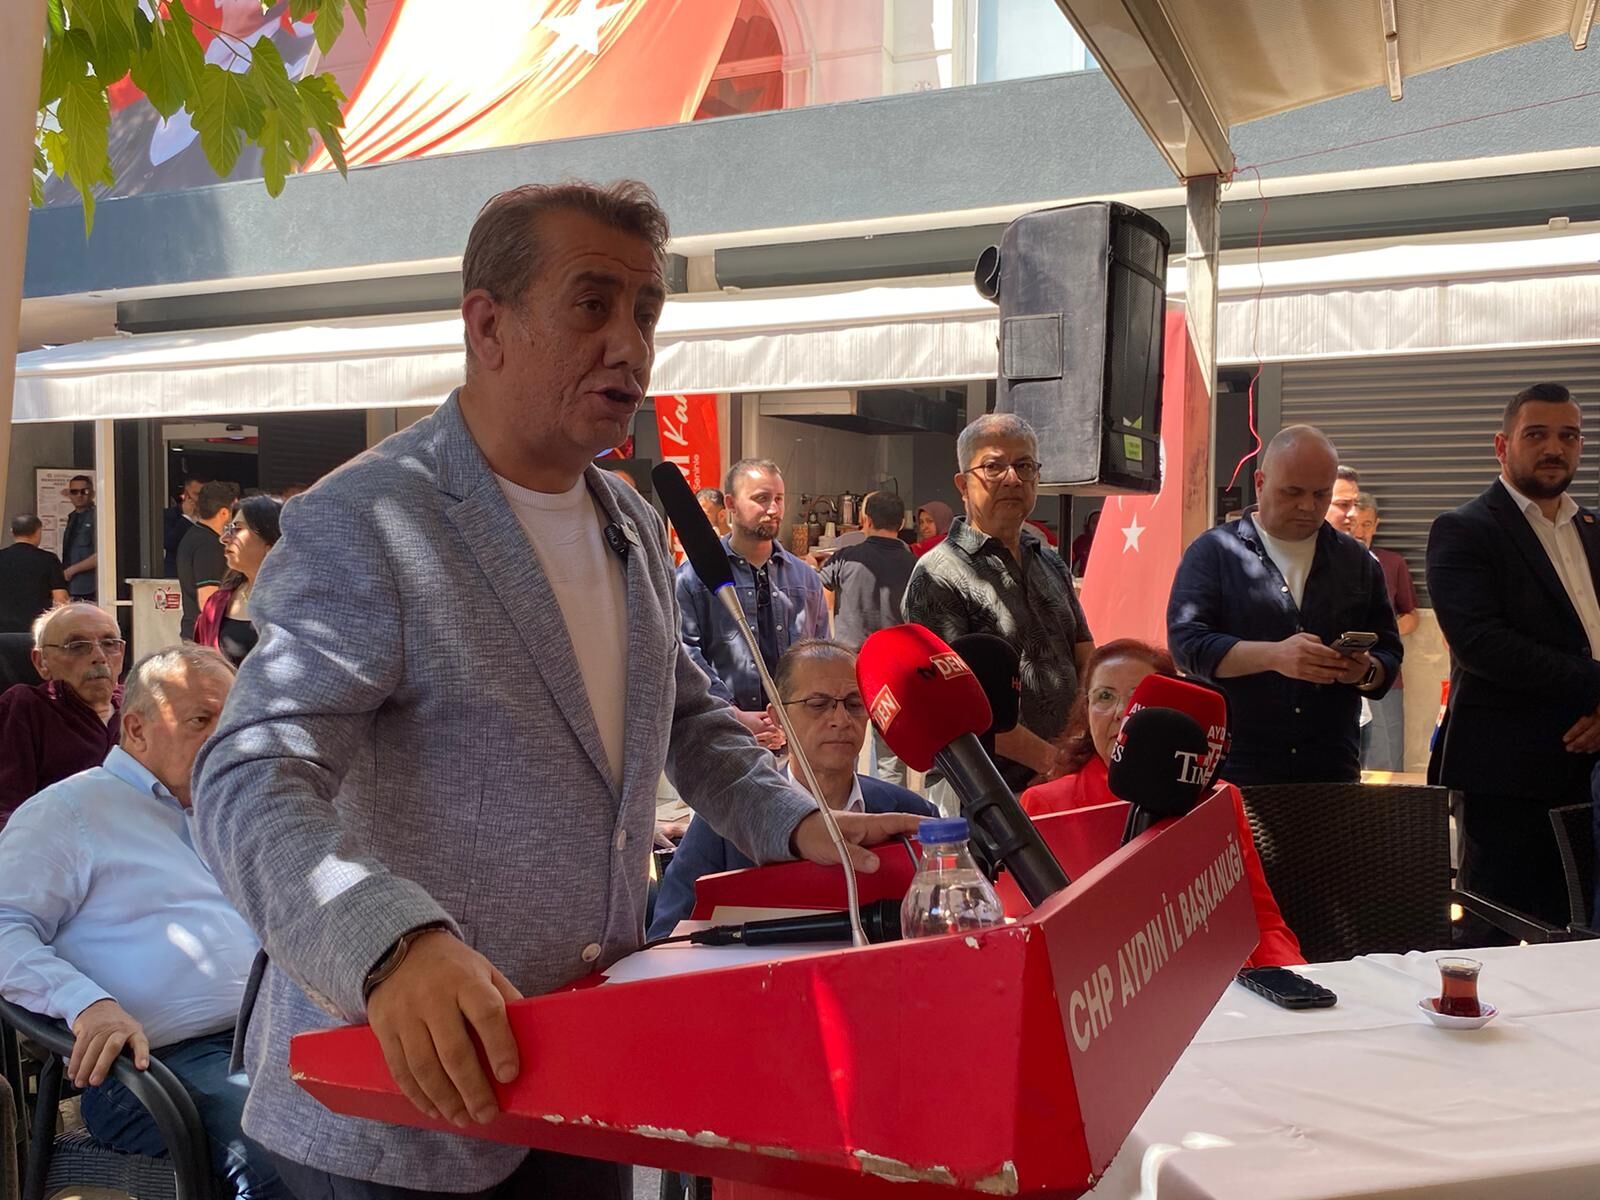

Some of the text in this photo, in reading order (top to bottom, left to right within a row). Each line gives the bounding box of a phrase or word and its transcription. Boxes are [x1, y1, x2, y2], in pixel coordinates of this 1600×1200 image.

[1069, 964, 1114, 1052] CHP
[1117, 914, 1169, 1008] AYDIN
[1162, 892, 1184, 953] İL
[1178, 832, 1245, 940] BAŞKANLIĞI
